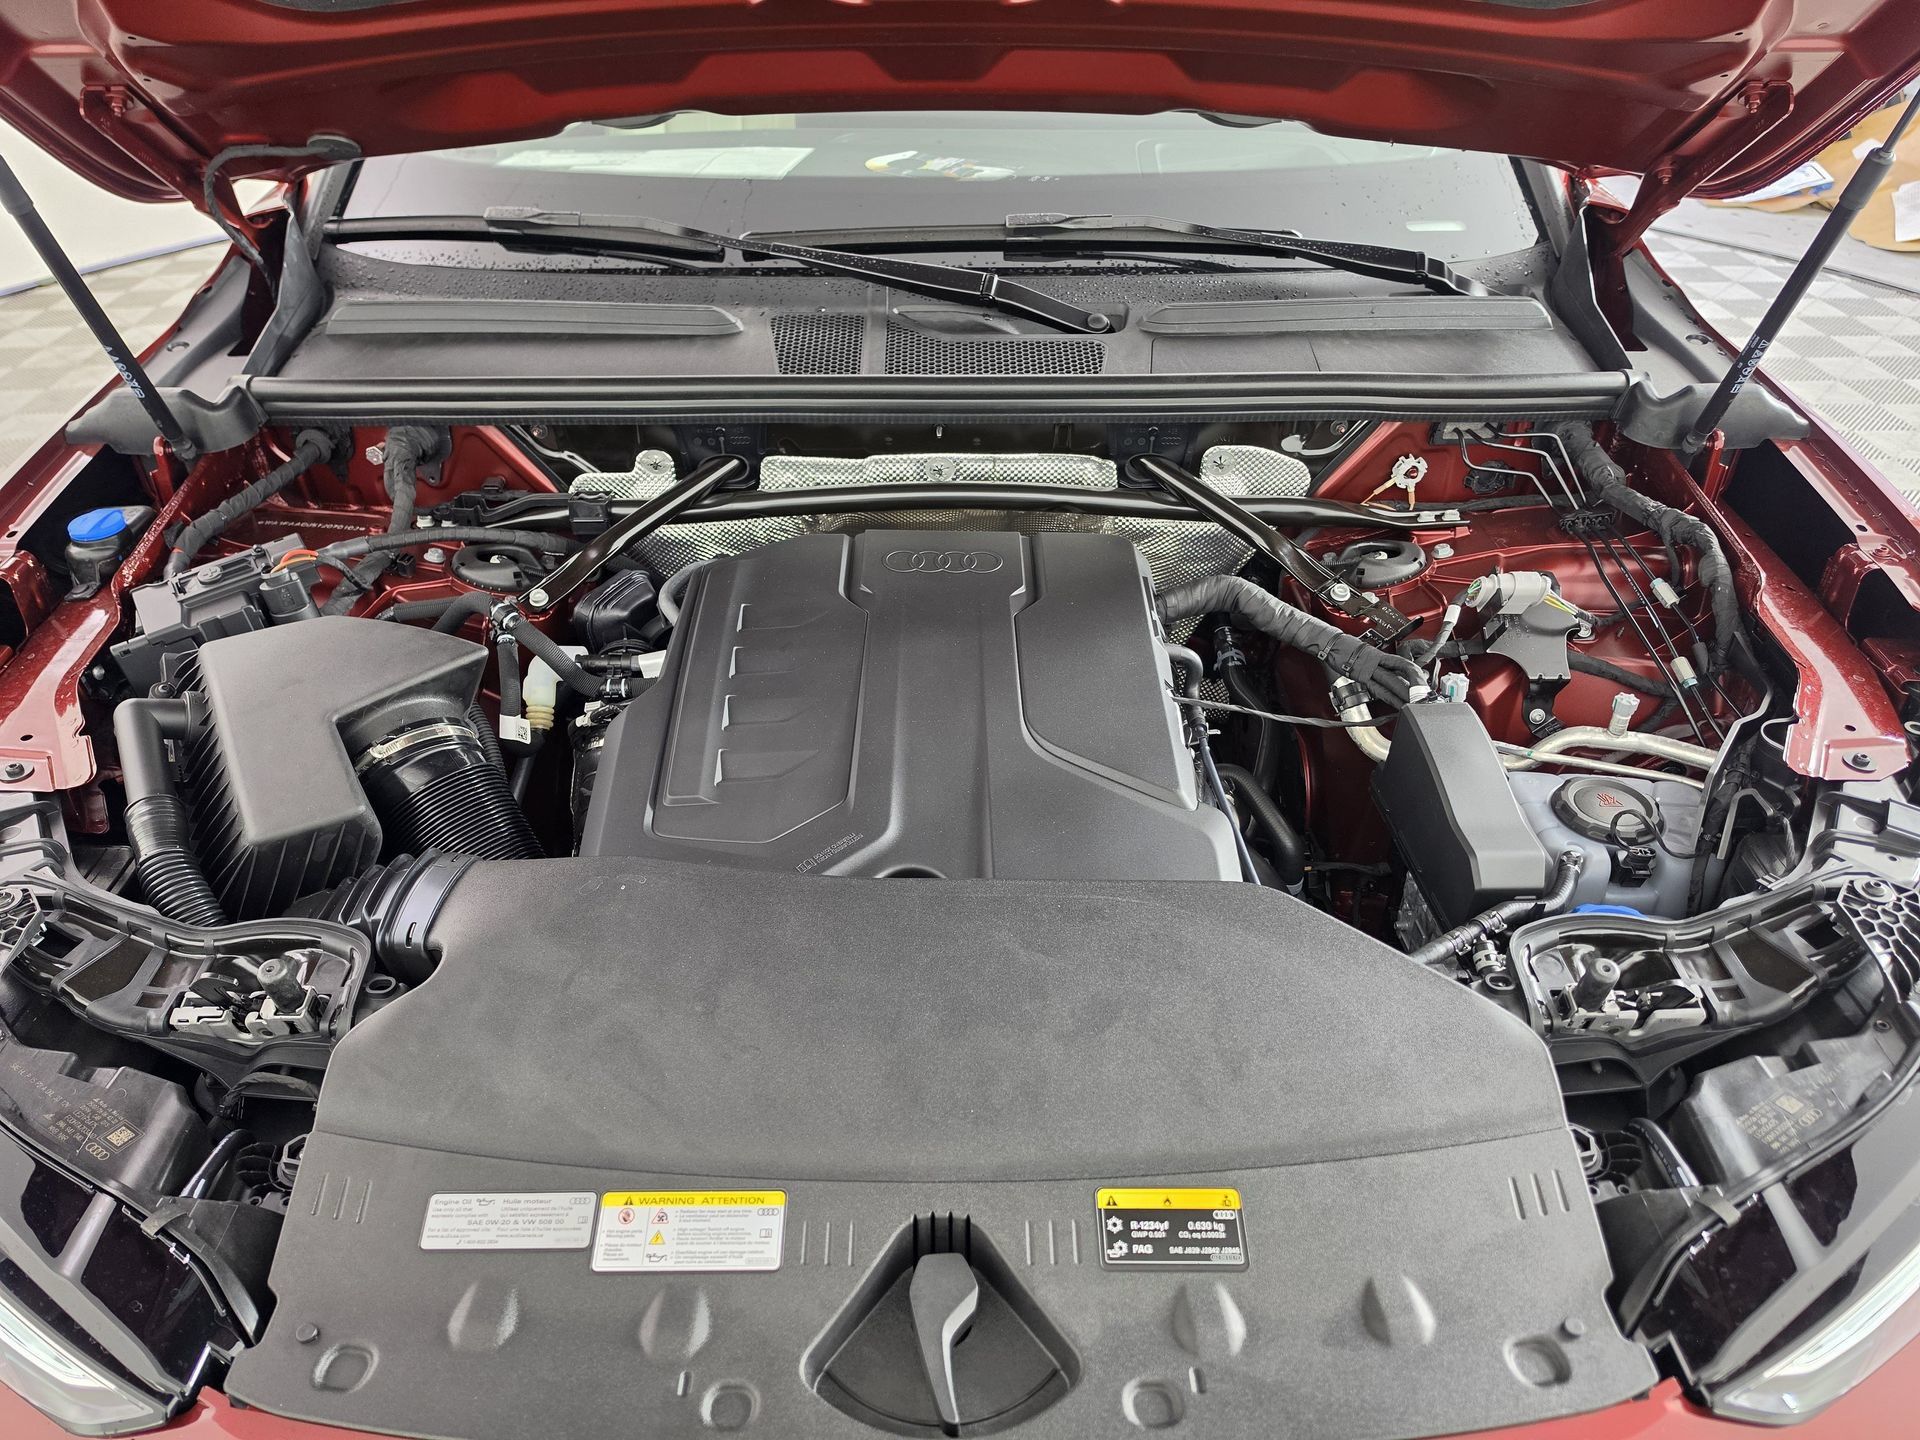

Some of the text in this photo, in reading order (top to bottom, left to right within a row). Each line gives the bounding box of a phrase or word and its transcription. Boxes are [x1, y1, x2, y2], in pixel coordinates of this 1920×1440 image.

[638, 1196, 765, 1205] WARNING ATTENTION
[1130, 1220, 1225, 1232] R-1234yf 0.630 kg
[1132, 1244, 1154, 1254] PAG
